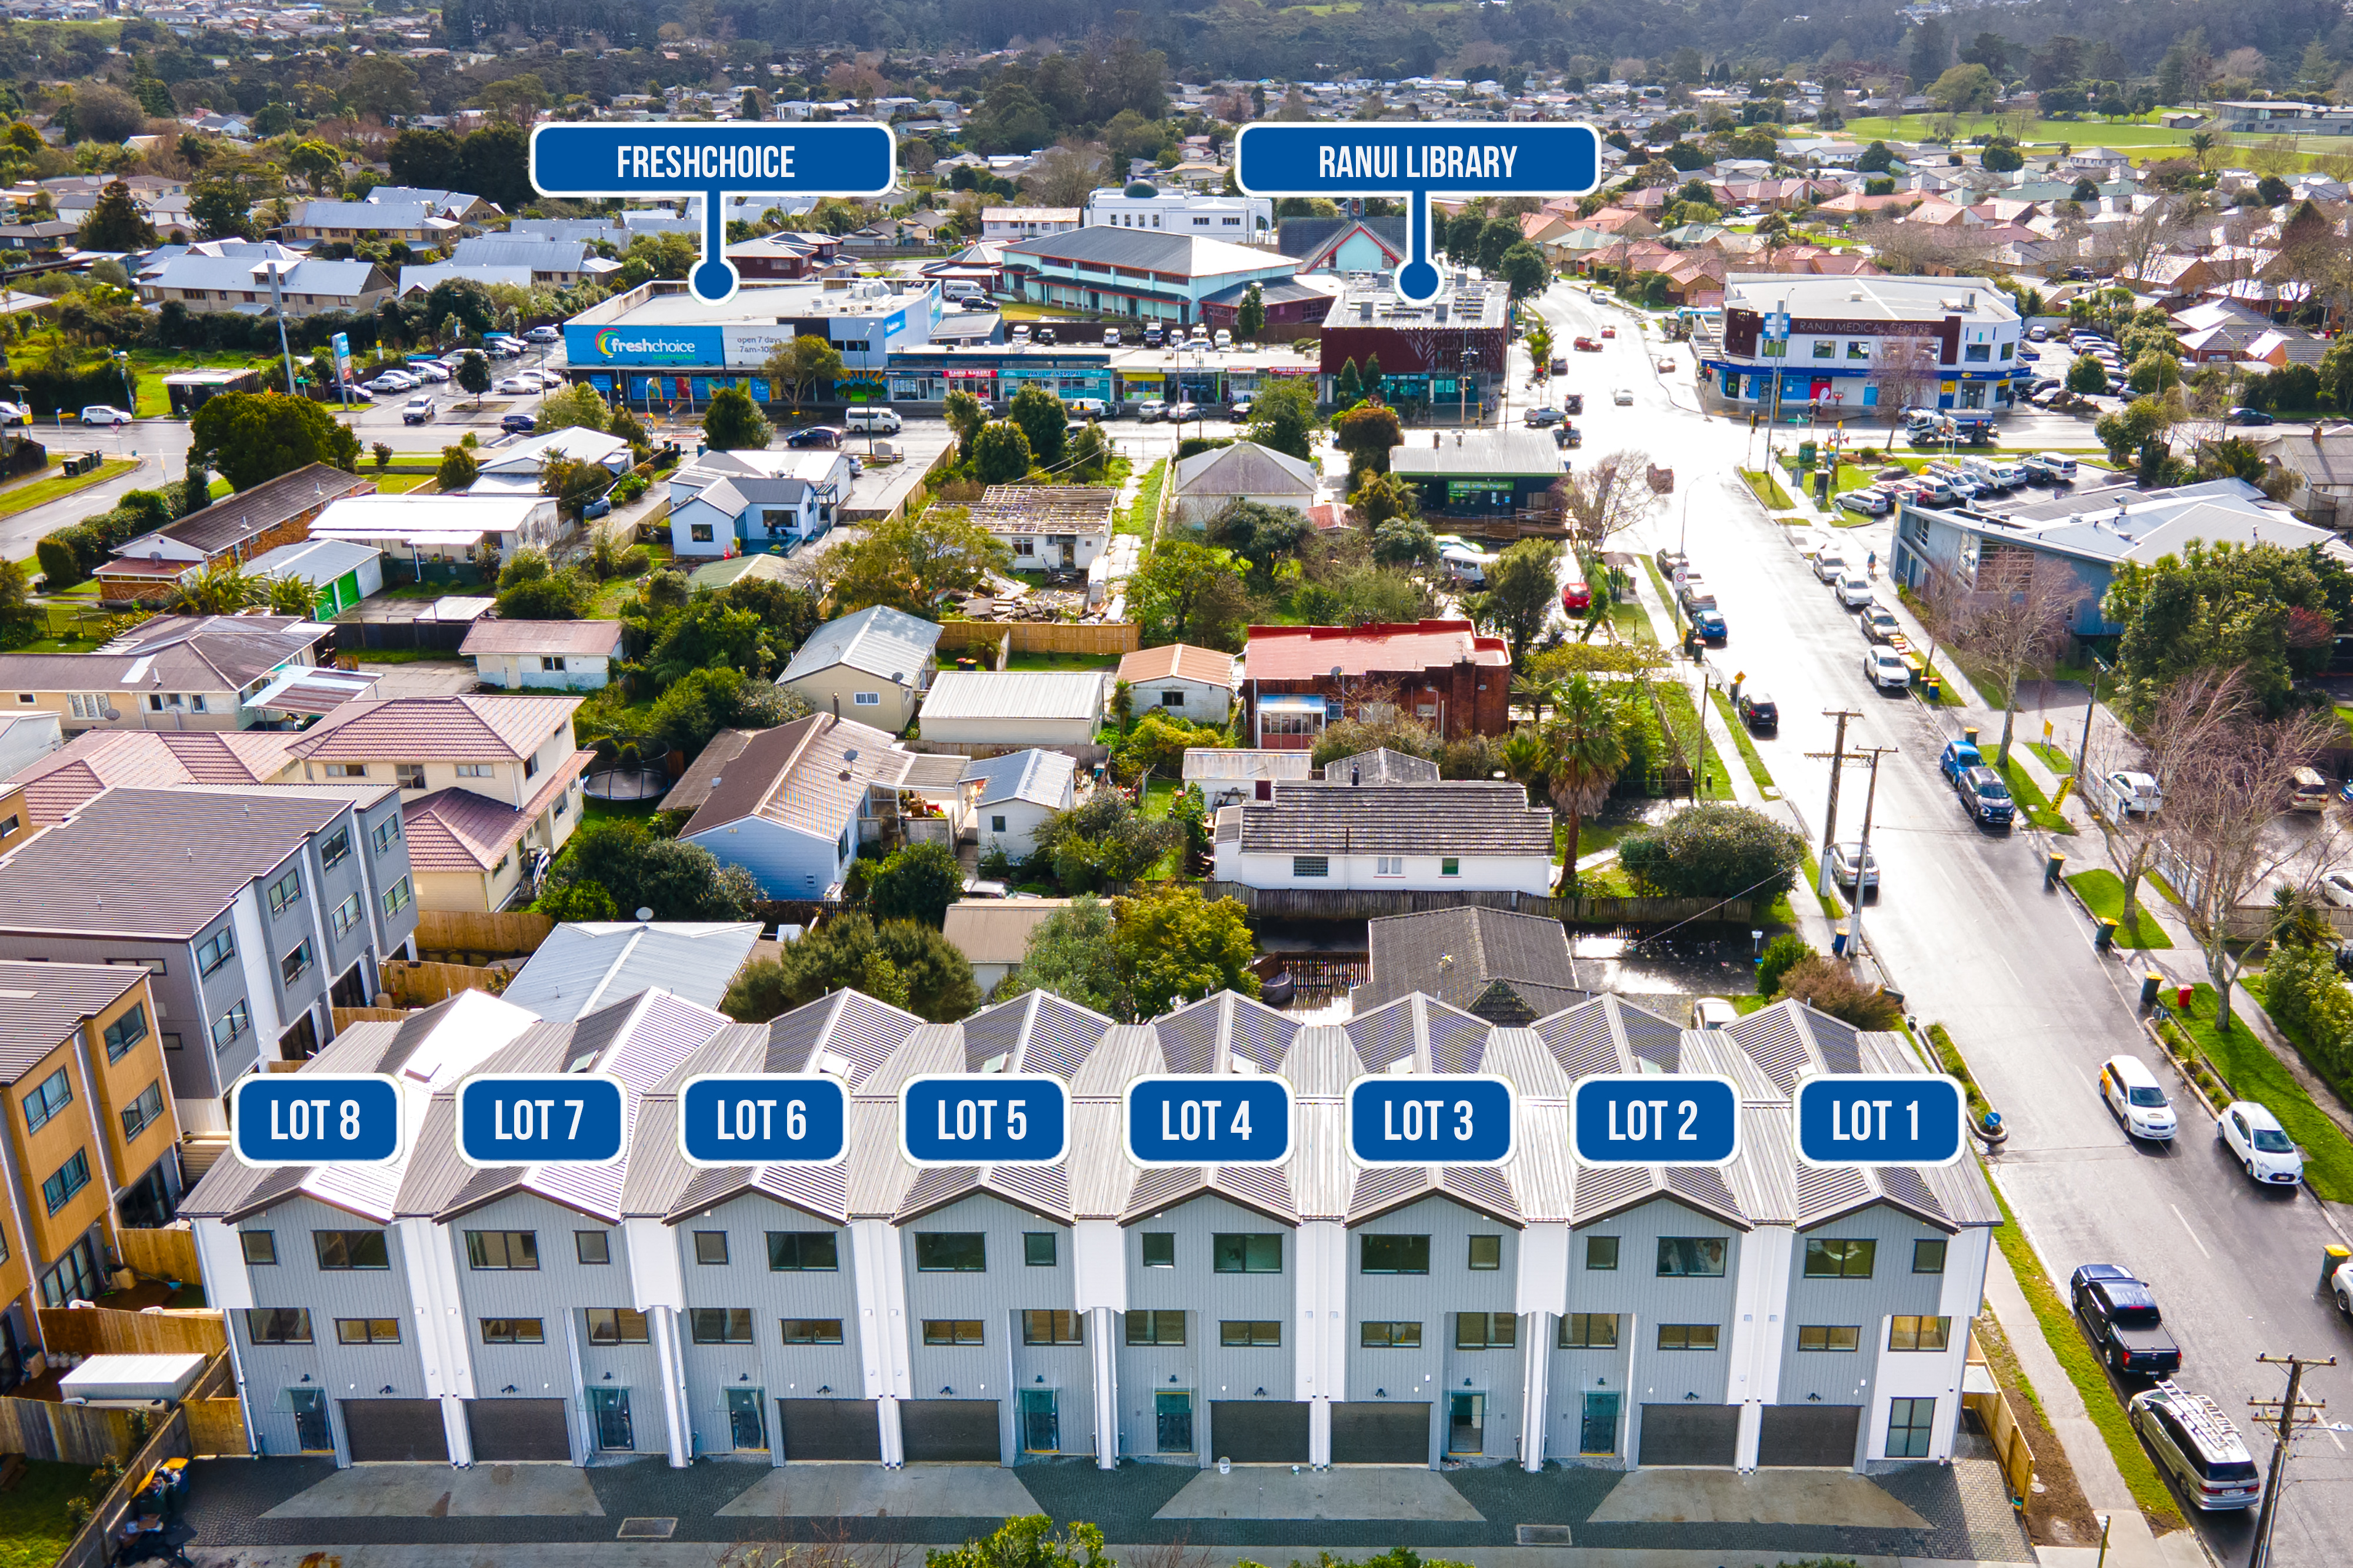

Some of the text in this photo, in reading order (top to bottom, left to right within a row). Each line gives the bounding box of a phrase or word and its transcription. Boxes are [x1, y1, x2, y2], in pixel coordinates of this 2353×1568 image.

[1735, 312, 1750, 321] 421
[1799, 321, 1833, 331] RANUI
[1836, 322, 1884, 332] MEDICAL
[611, 338, 695, 353] freshchoice
